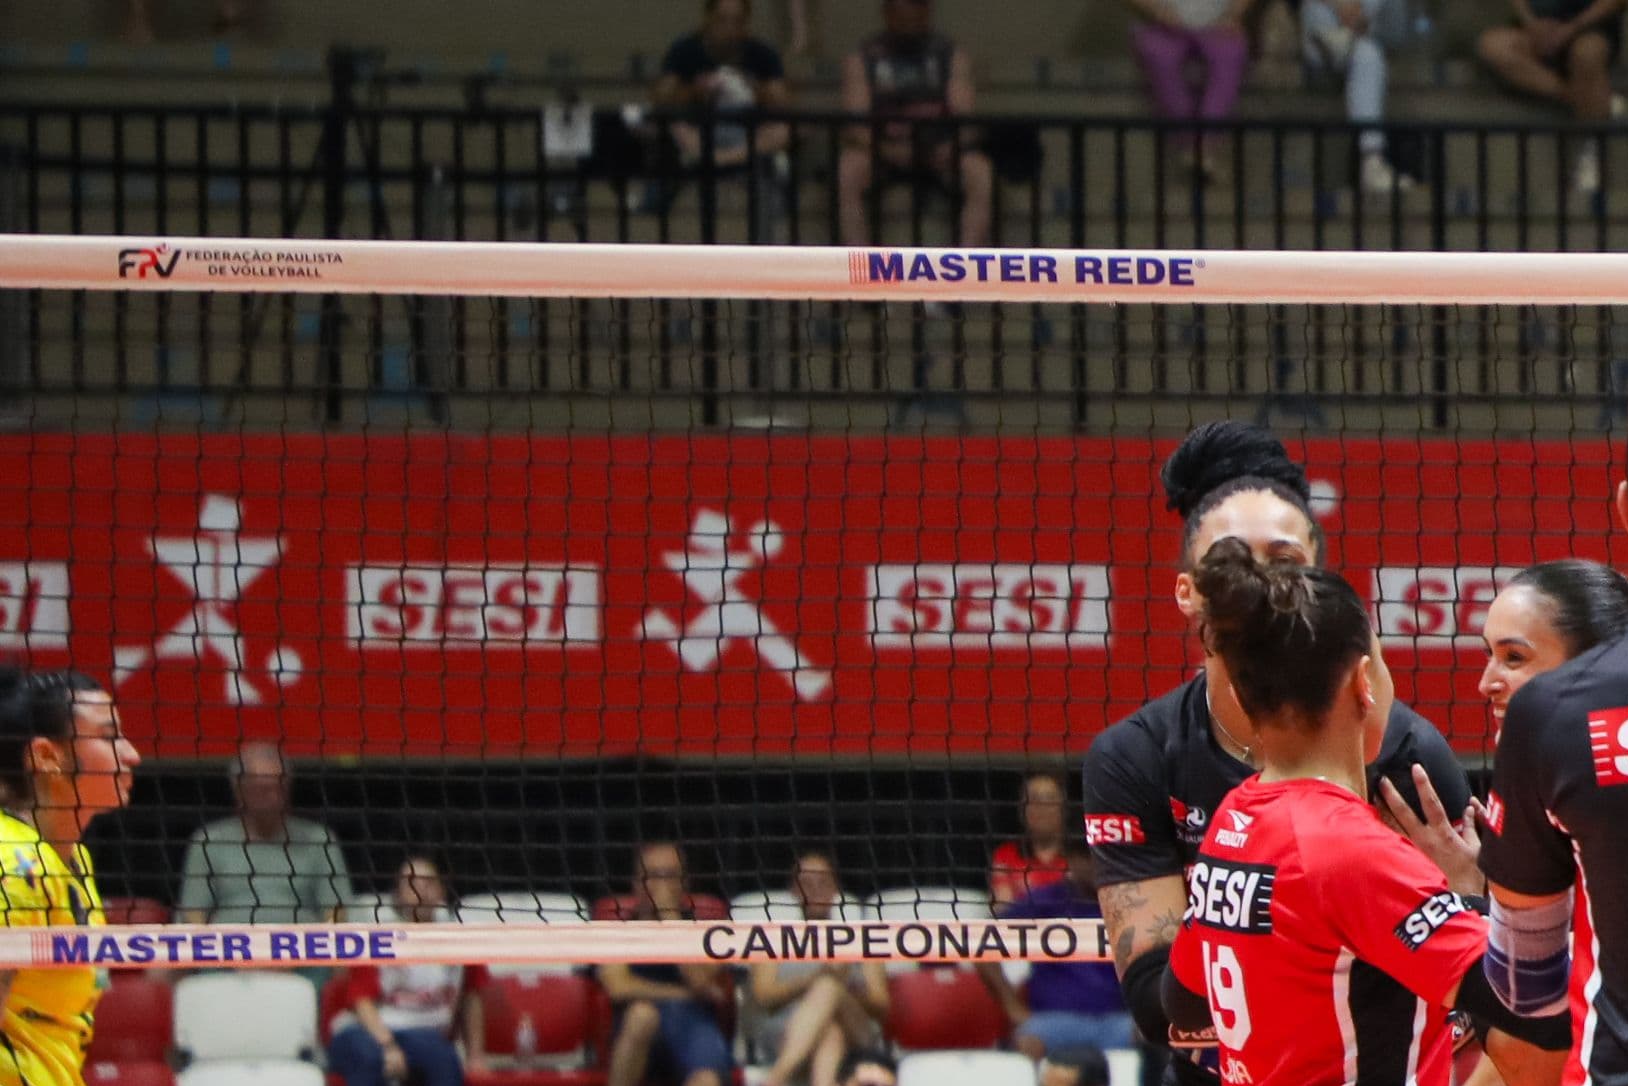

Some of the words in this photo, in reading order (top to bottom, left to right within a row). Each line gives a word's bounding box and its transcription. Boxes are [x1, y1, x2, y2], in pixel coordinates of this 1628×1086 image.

[186, 249, 272, 265] FEDERAÇÃO
[277, 251, 343, 264] PAULISTA
[208, 265, 226, 276] DE
[868, 252, 1058, 284] MASTER
[1075, 255, 1195, 286] REDE
[371, 576, 572, 637] SESI
[890, 577, 1086, 635] SESI
[1396, 577, 1507, 635] SE
[1184, 861, 1261, 929] SESI
[52, 931, 251, 963] MASTER
[270, 930, 396, 960] REDE
[702, 923, 1078, 960] CAMPEONATO
